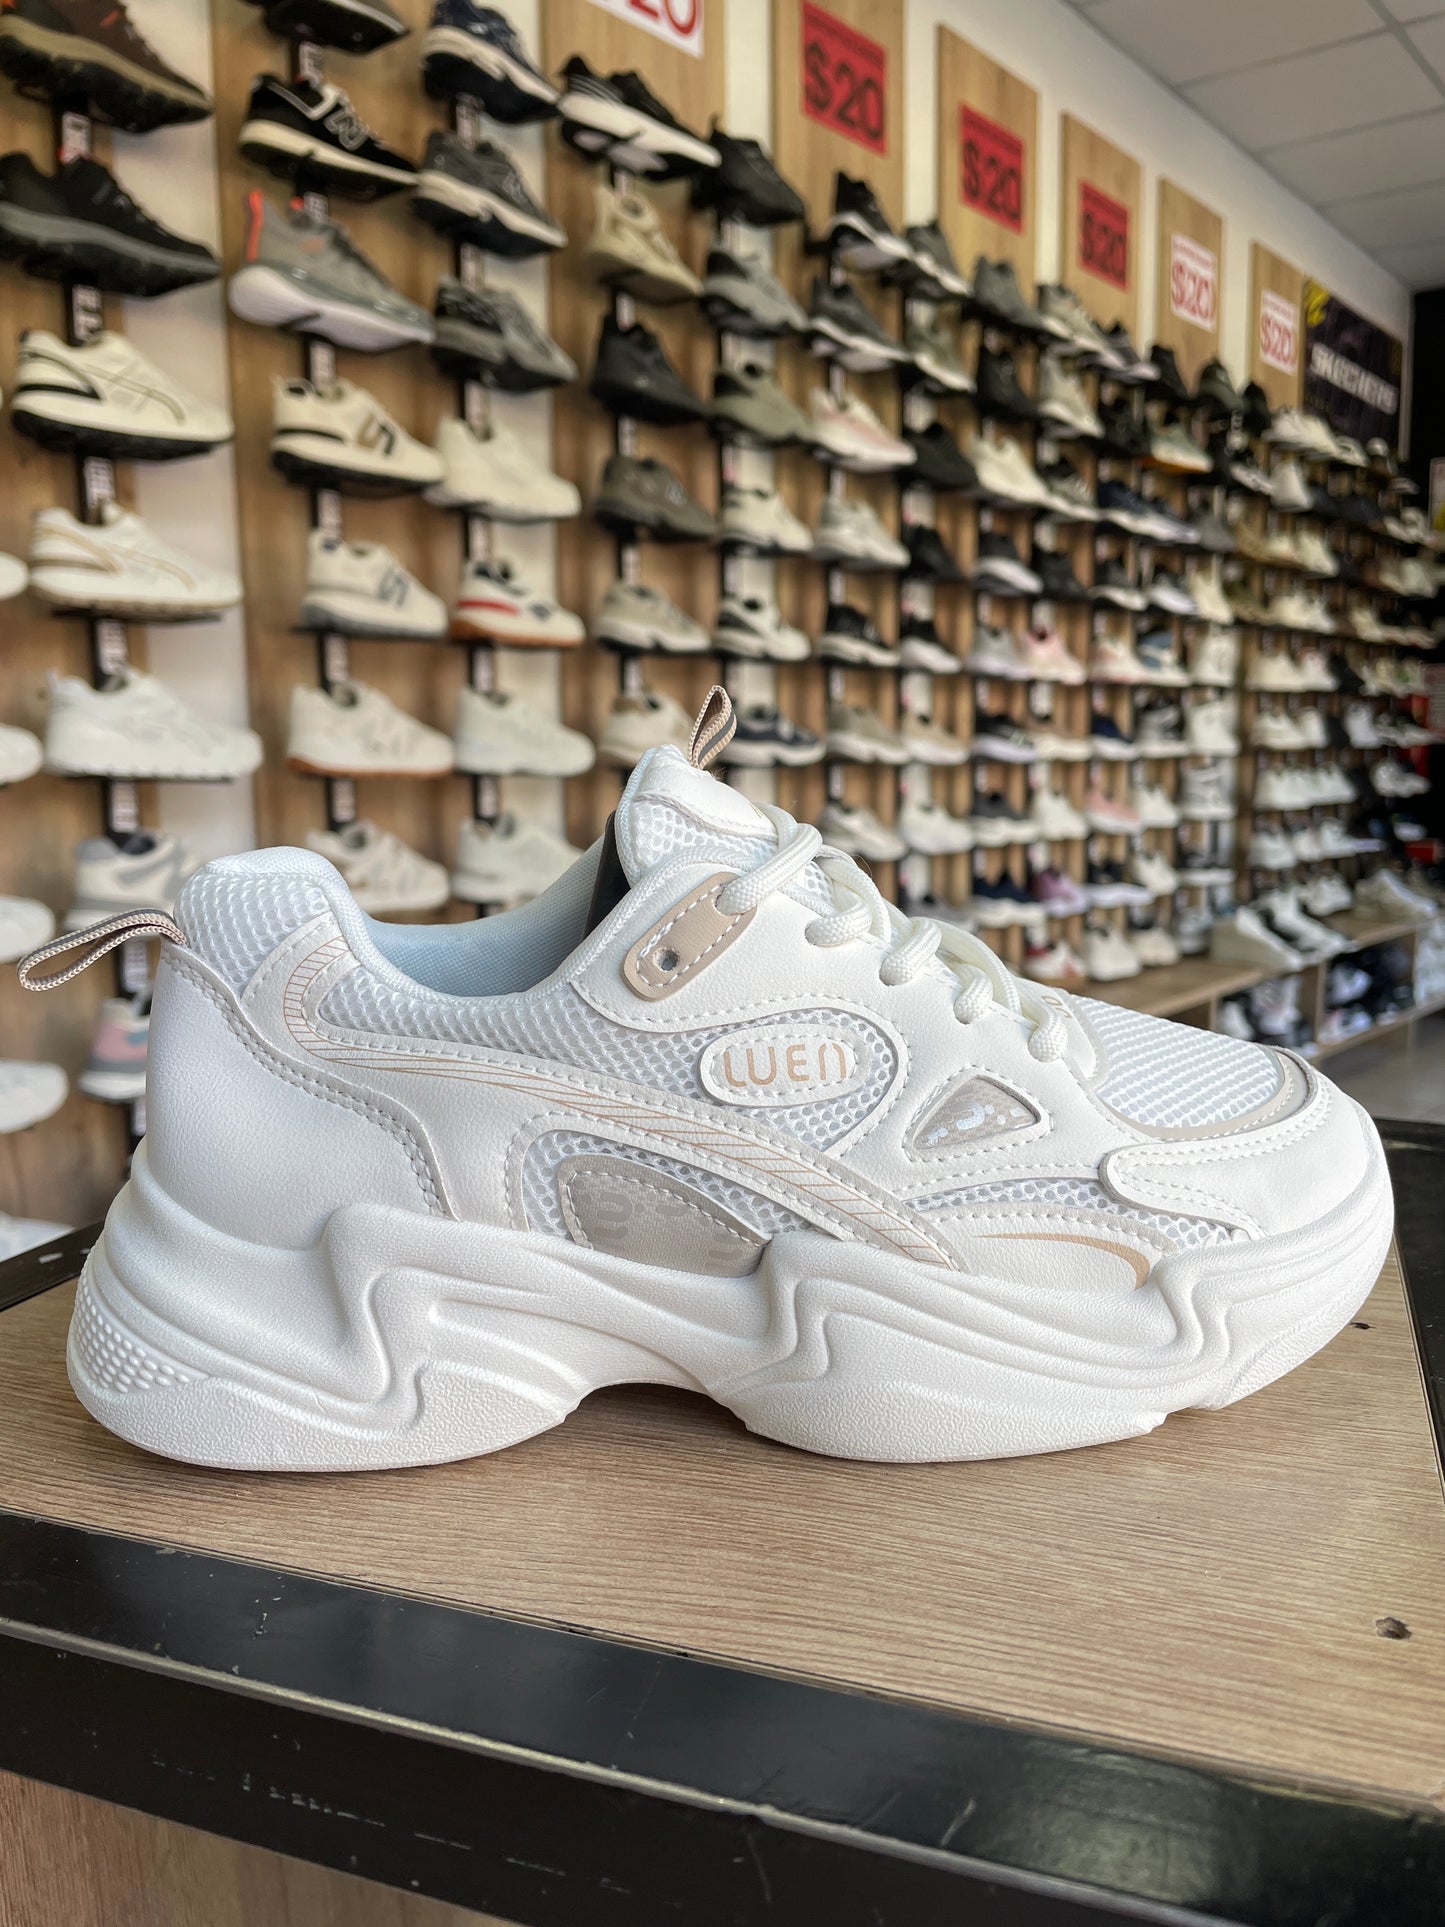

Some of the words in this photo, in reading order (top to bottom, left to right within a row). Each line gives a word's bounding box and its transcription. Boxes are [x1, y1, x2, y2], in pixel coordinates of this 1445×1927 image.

[804, 40, 885, 142] $20
[963, 140, 1022, 221] $20
[1081, 211, 1128, 283] $20
[1171, 260, 1214, 322] $20
[1261, 314, 1296, 366] $20
